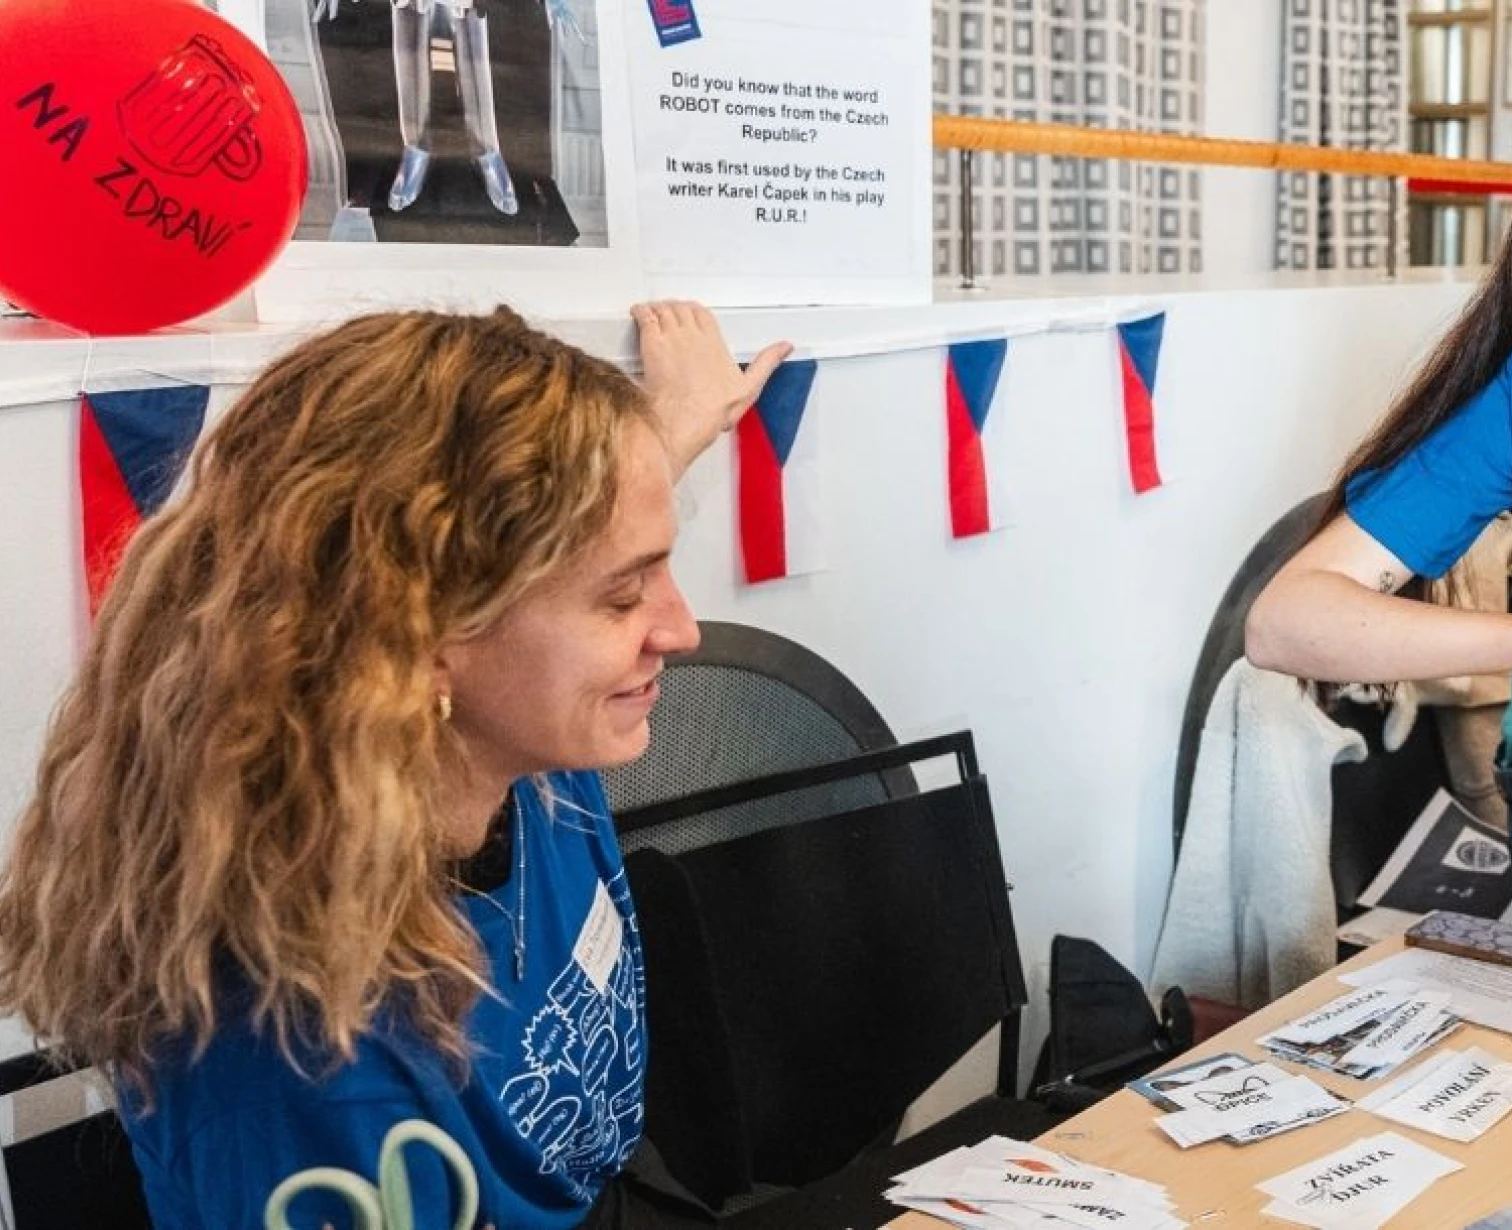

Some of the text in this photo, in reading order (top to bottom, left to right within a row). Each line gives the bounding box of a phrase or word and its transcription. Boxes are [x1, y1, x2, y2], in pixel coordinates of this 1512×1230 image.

[671, 71, 879, 104] Did you know that the word
[660, 95, 889, 126] ROBOT comes from the Czech
[742, 125, 819, 143] Republic?
[15, 81, 254, 259] NA ZDRAVÍ
[666, 157, 885, 183] It was first used by the Czech
[668, 182, 885, 207] writer Karel Čapek in his play
[756, 208, 807, 223] R.U.R.!
[1004, 1173, 1094, 1190] SMUTEK
[1303, 1151, 1394, 1189] ZVÍŘATA
[1331, 1175, 1389, 1202] DJUR
